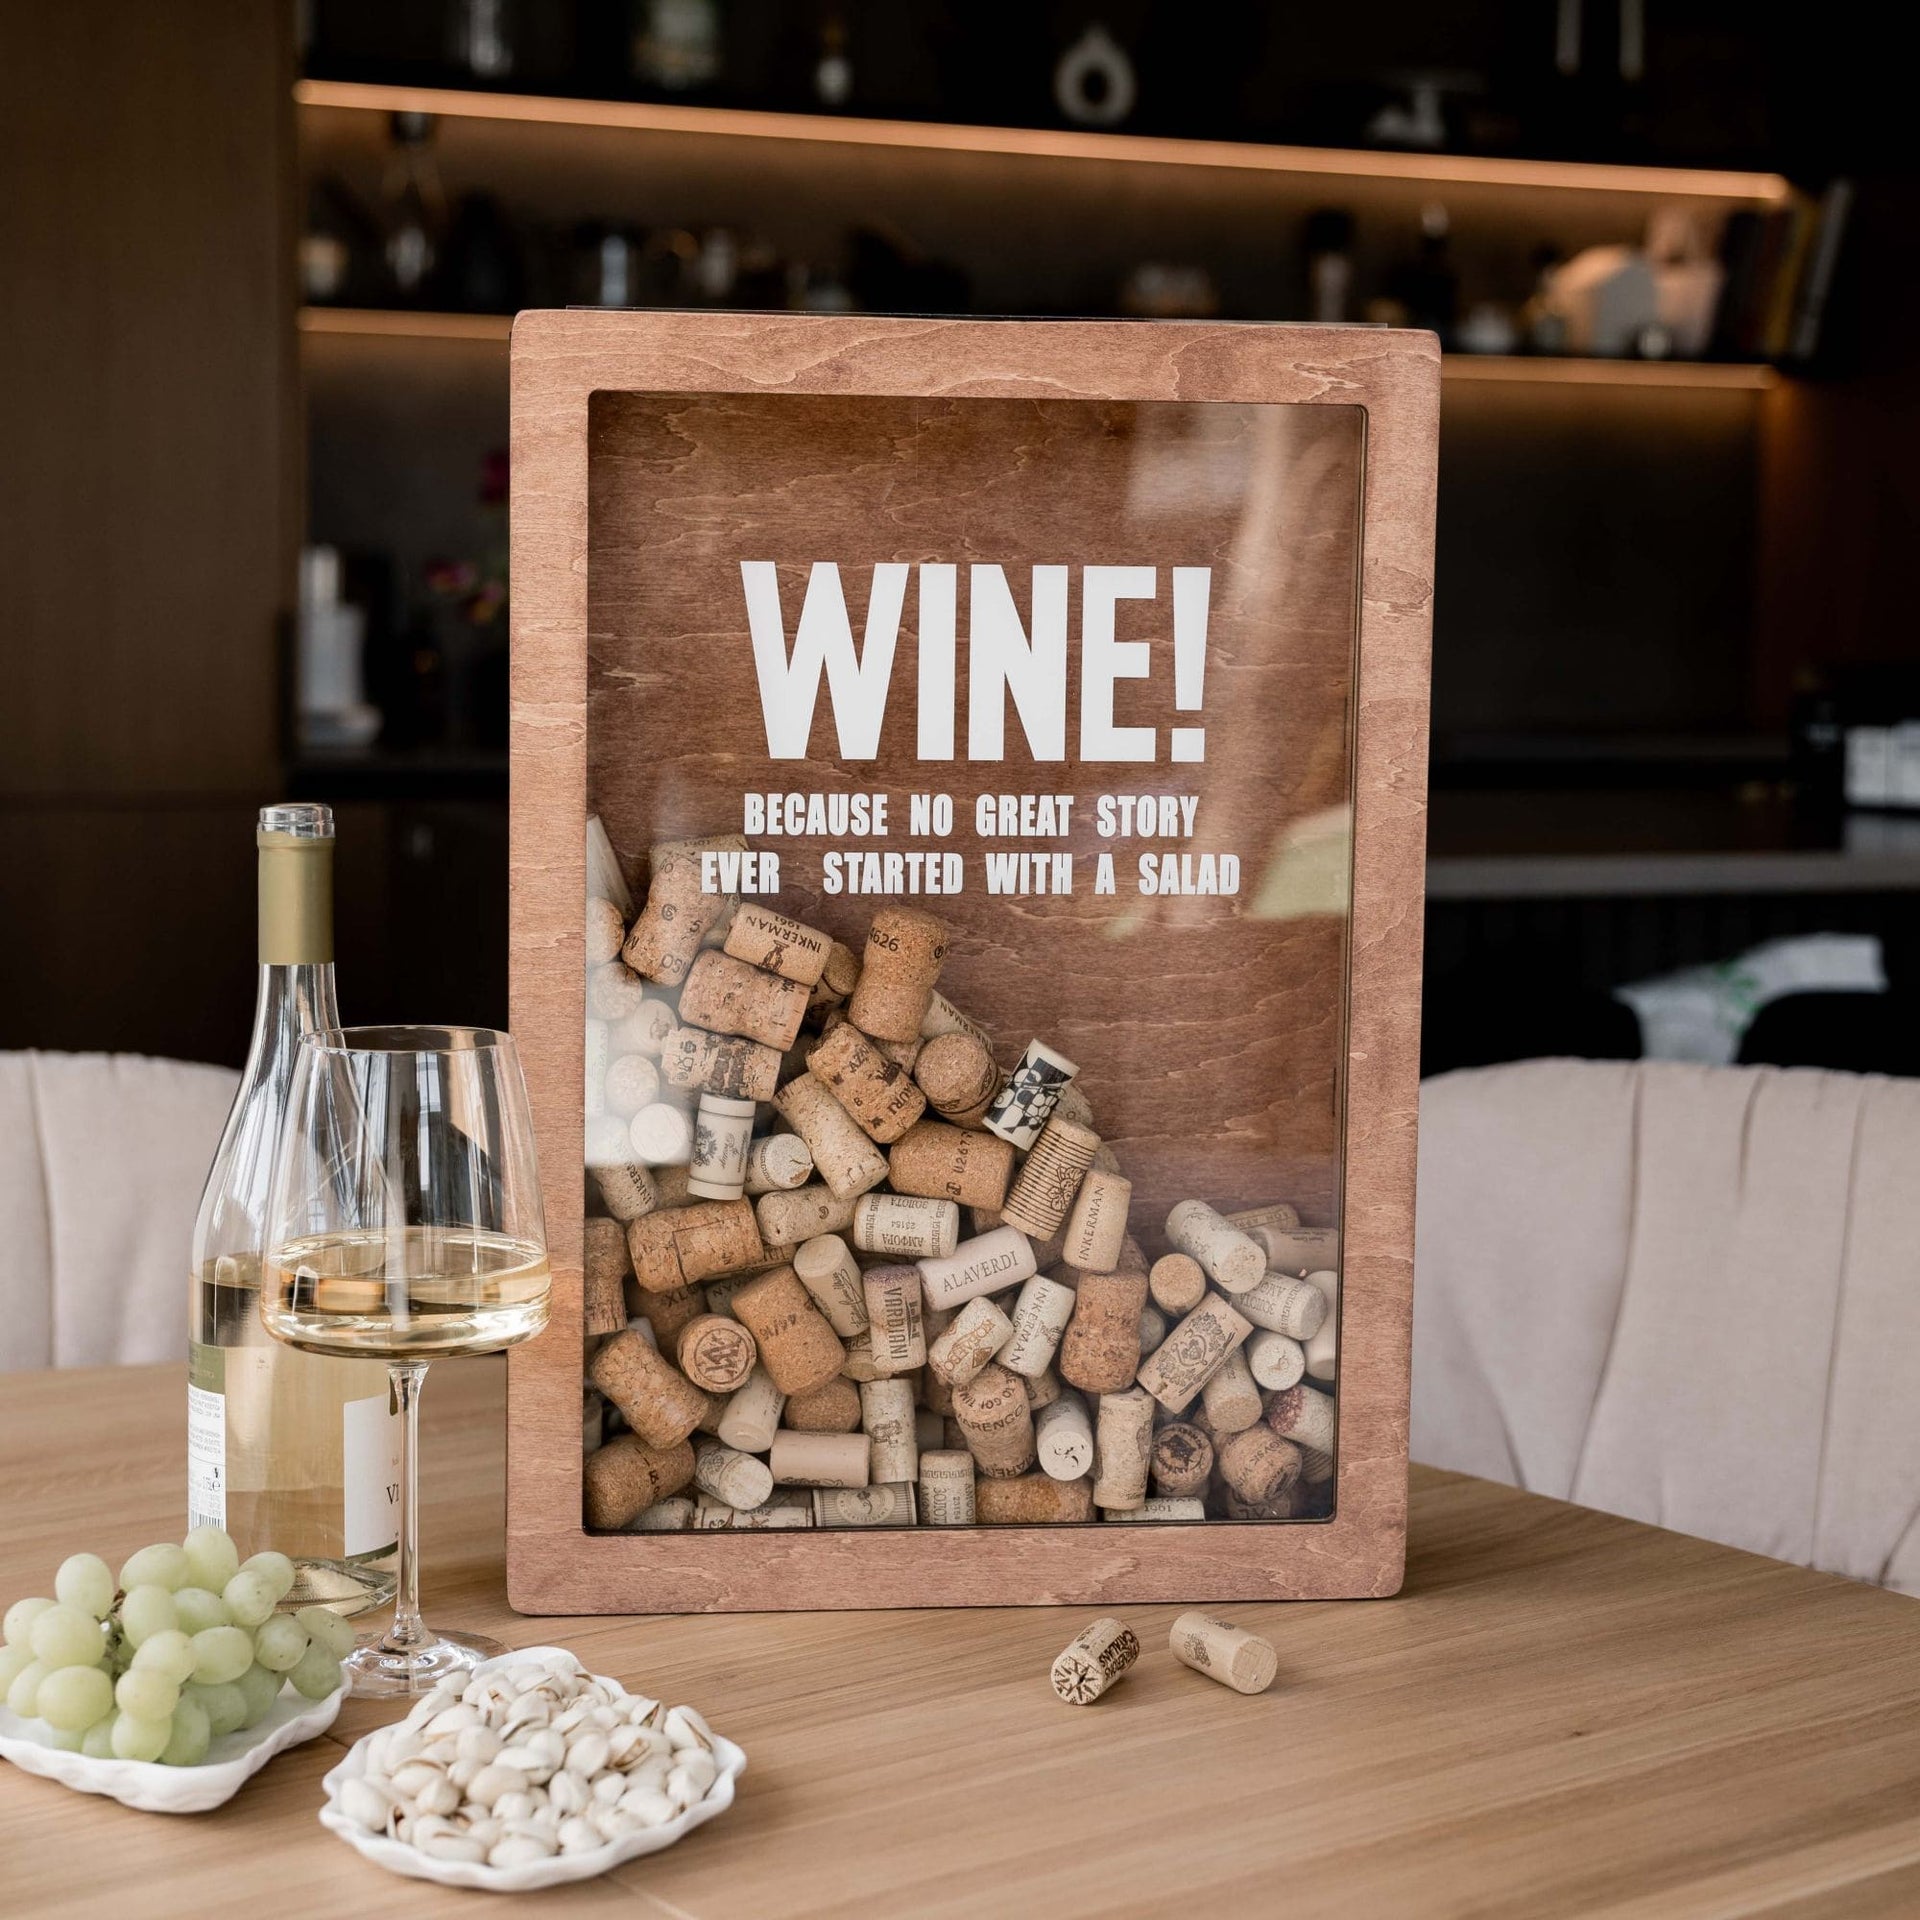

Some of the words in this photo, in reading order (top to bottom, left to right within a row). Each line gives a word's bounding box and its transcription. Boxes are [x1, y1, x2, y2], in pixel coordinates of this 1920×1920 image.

[740, 561, 1211, 762] WINE!
[744, 793, 888, 836] BECAUSE
[910, 794, 954, 836] NO
[976, 794, 1074, 837] GREAT
[1096, 795, 1199, 838] STORY
[701, 851, 780, 894] EVER
[822, 851, 963, 895] STARTED
[985, 852, 1073, 895] WITH
[1095, 853, 1116, 895] A
[1138, 853, 1241, 896] SALAD
[746, 916, 821, 953] INKERMAN
[1078, 1185, 1105, 1261] INKERMAN
[942, 1250, 1019, 1292] ALAVERDI
[884, 1287, 908, 1360] VARDIANI
[1010, 1287, 1049, 1365] INKERMAN
[980, 1399, 1002, 1410] GO!
[1002, 1388, 1015, 1400] TO
